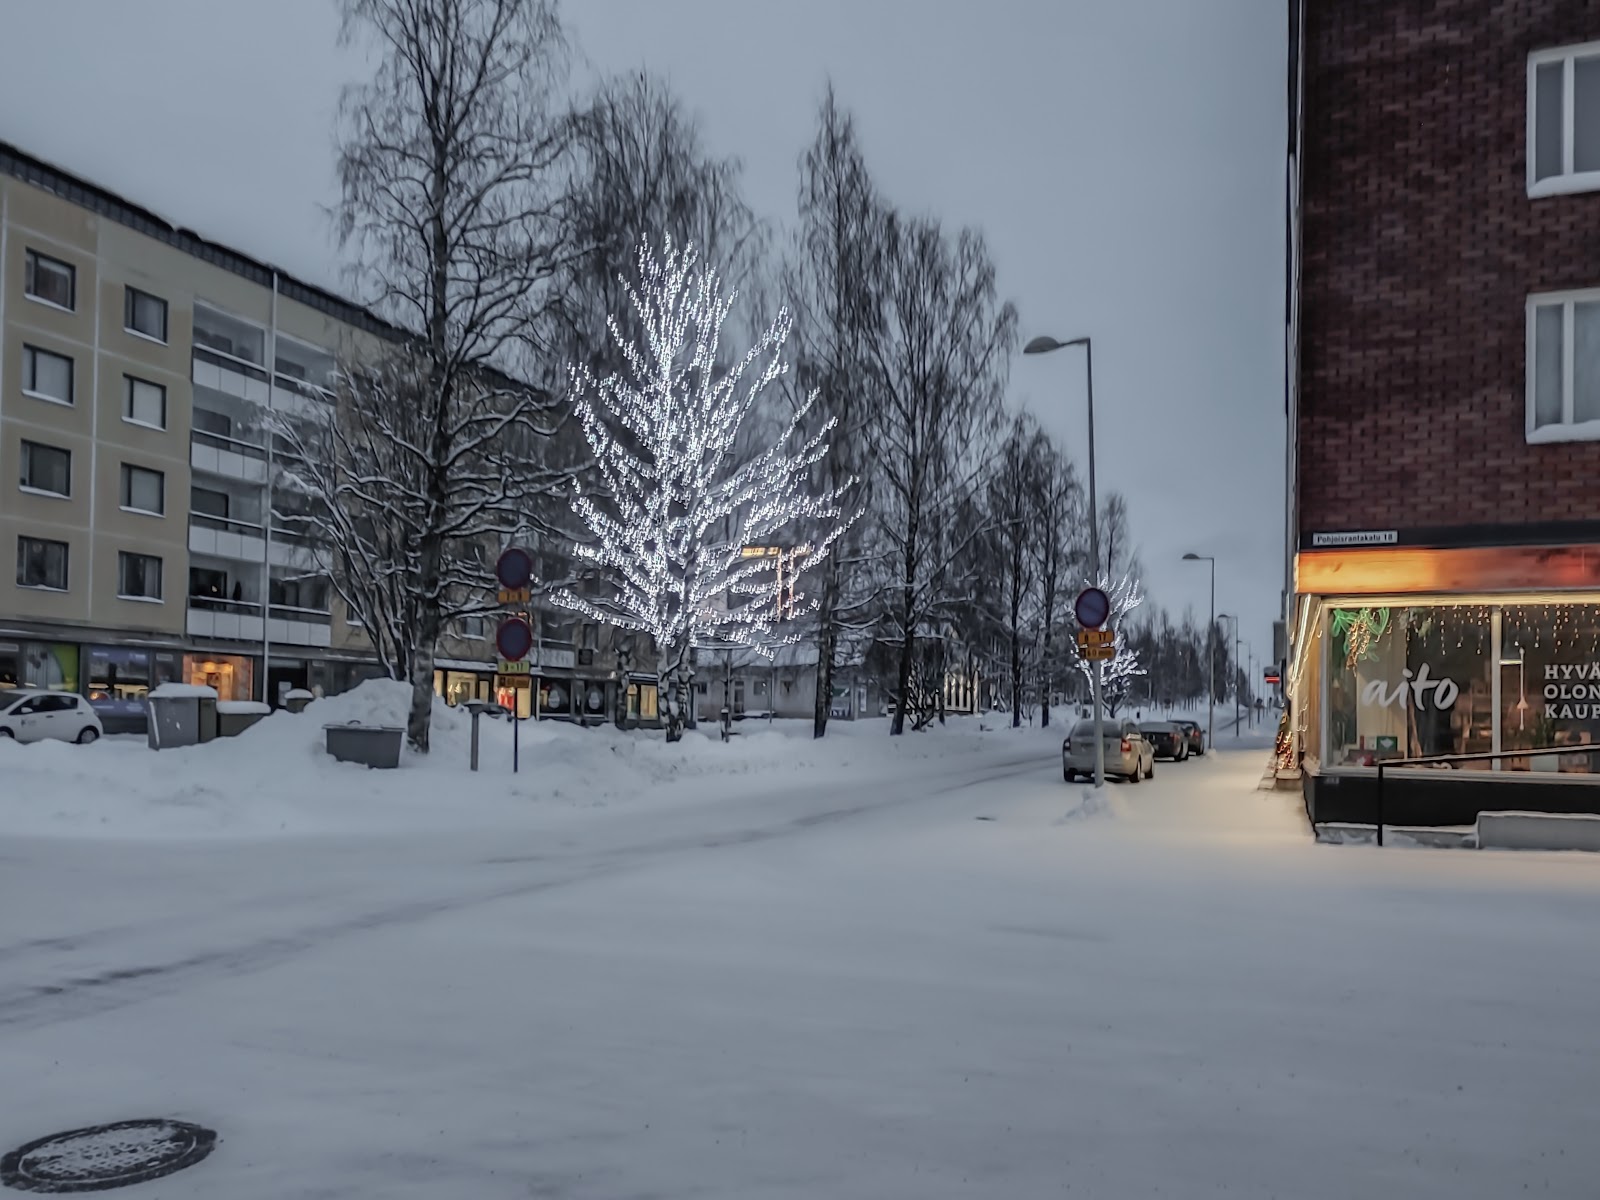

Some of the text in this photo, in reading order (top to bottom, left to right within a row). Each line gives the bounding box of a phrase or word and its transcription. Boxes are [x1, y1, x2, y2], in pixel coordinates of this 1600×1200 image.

[1317, 534, 1381, 544] Pohjoisrantakatu
[1544, 661, 1600, 680] HYVÄ
[1362, 662, 1459, 711] aito
[1543, 683, 1600, 700] OLON
[1544, 703, 1600, 720] KAUP
